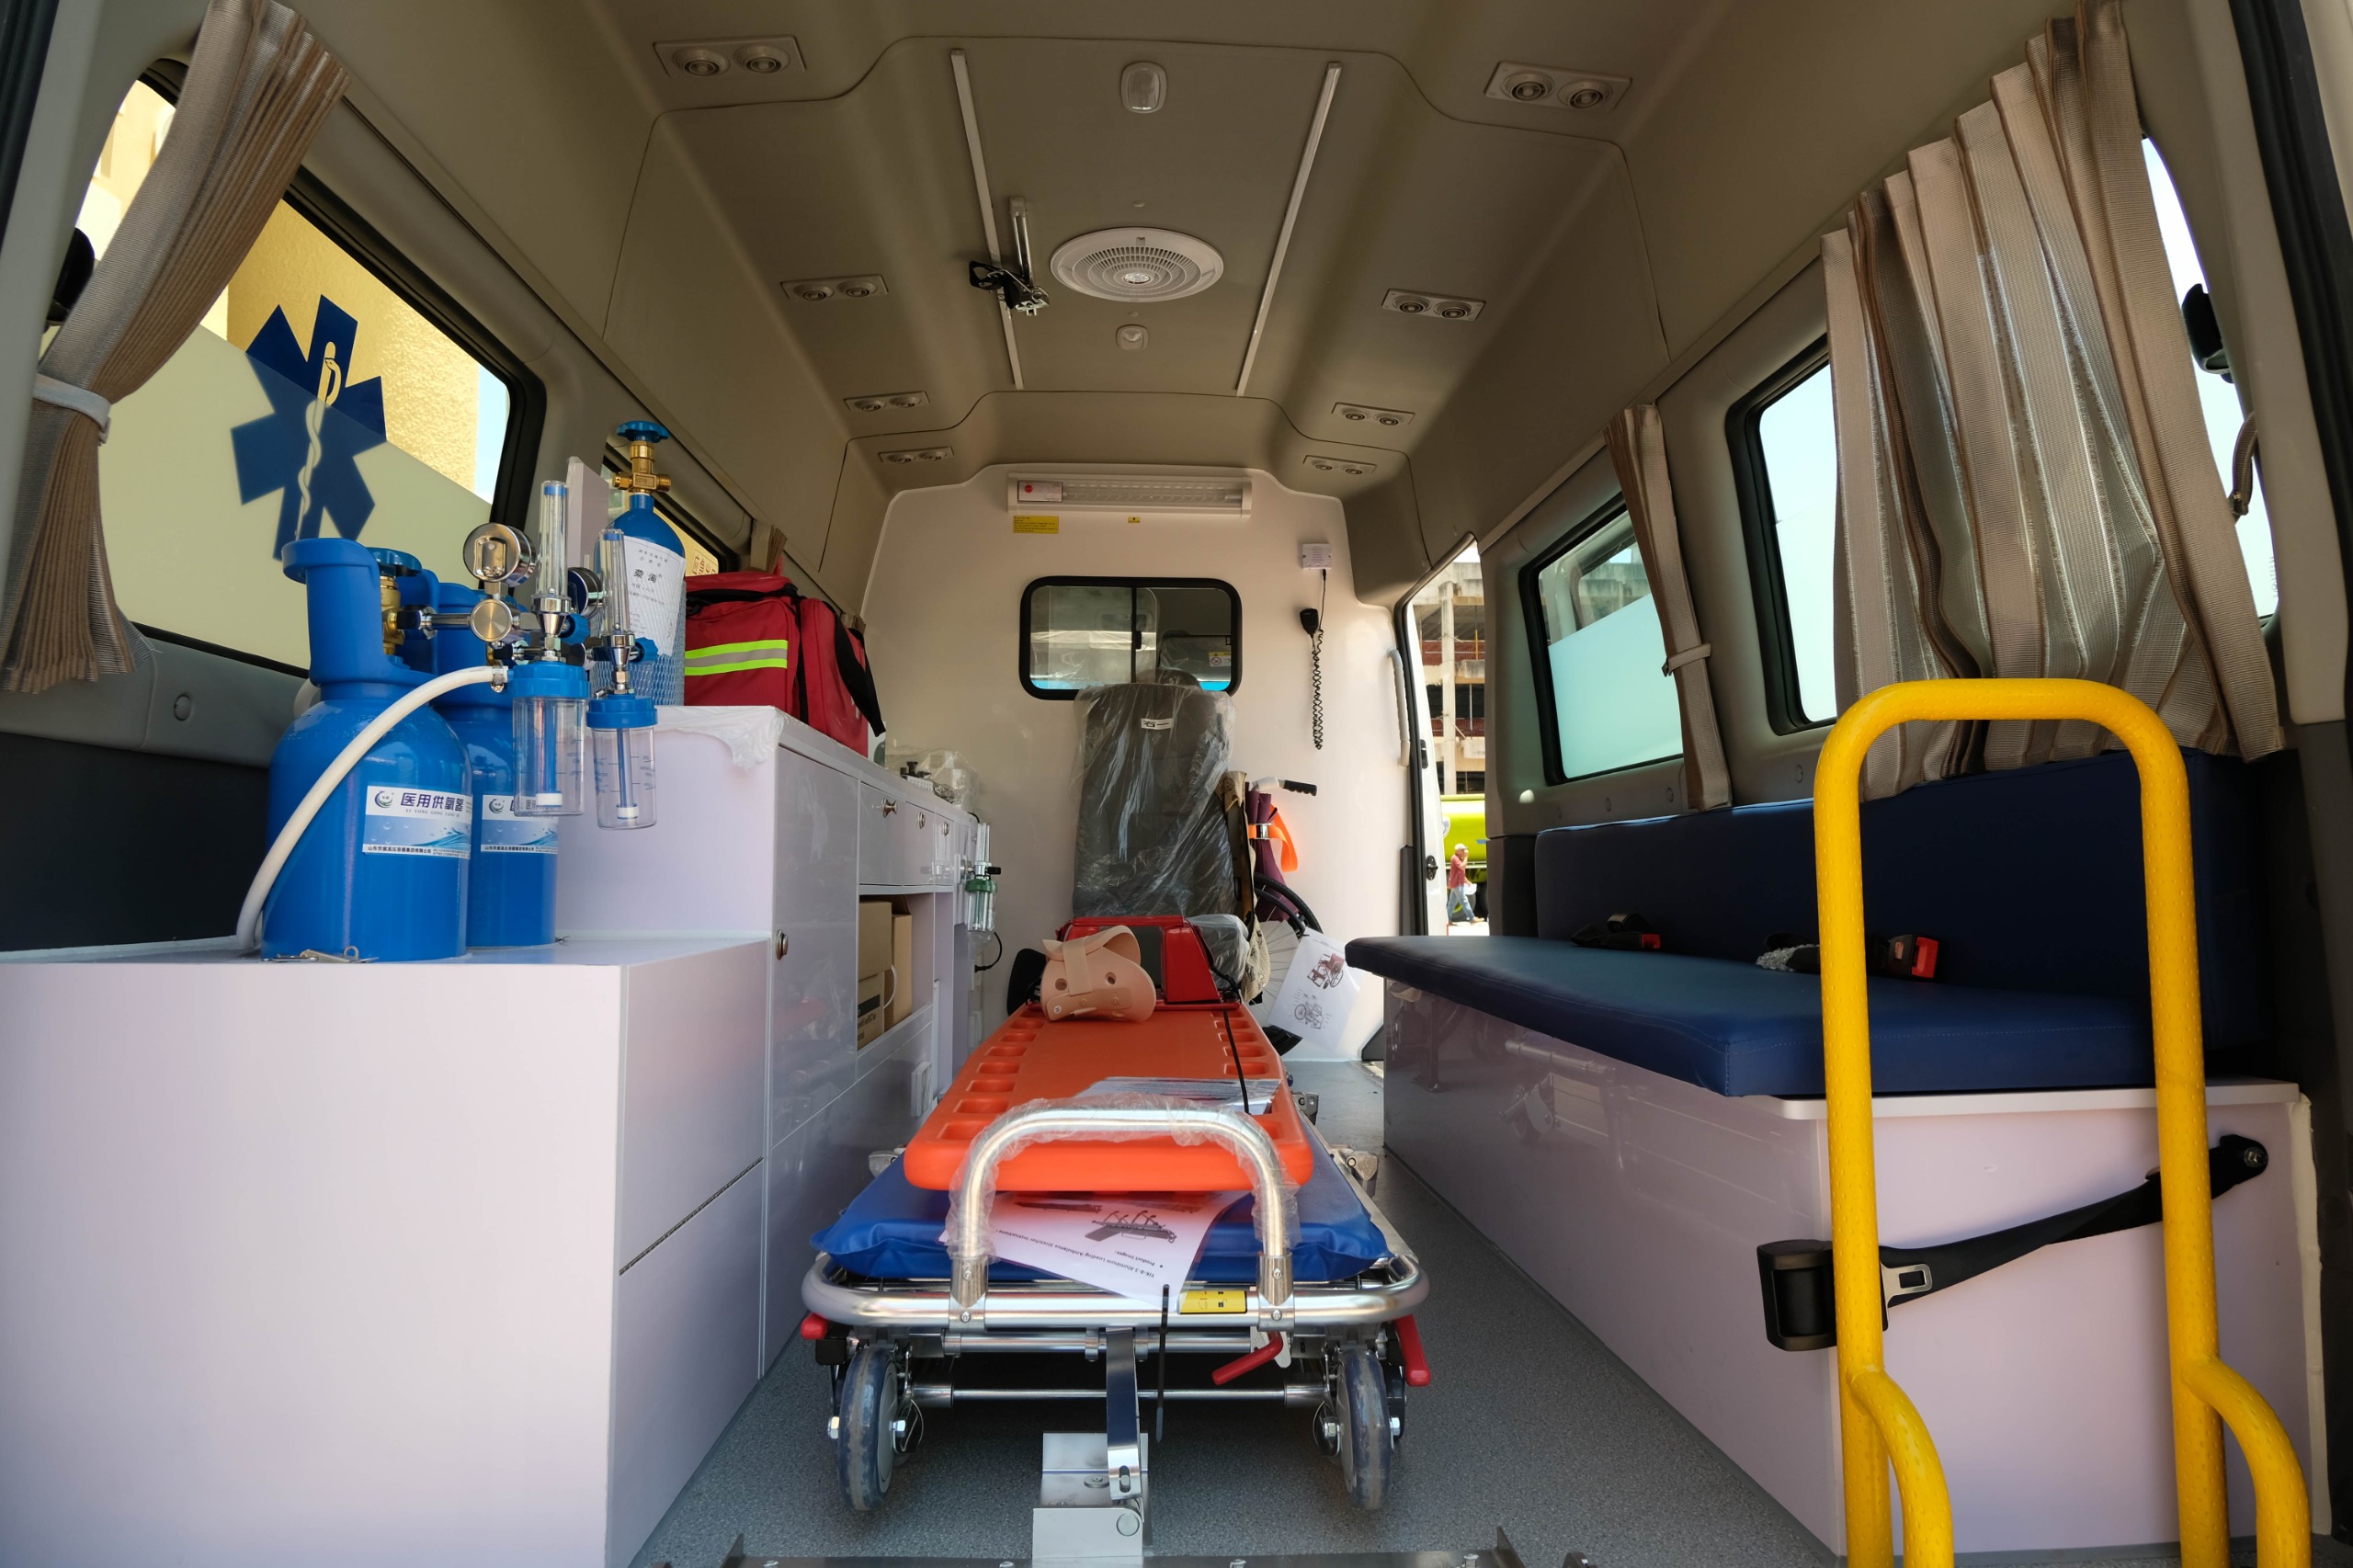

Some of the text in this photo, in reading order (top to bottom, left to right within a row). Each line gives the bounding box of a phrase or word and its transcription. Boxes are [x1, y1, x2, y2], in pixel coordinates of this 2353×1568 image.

[400, 791, 464, 812] 医用供氧器
[1029, 1237, 1054, 1248] Stretcher
[1054, 1244, 1085, 1256] Ambulance
[1085, 1252, 1106, 1263] Loading
[1135, 1256, 1155, 1267] Product
